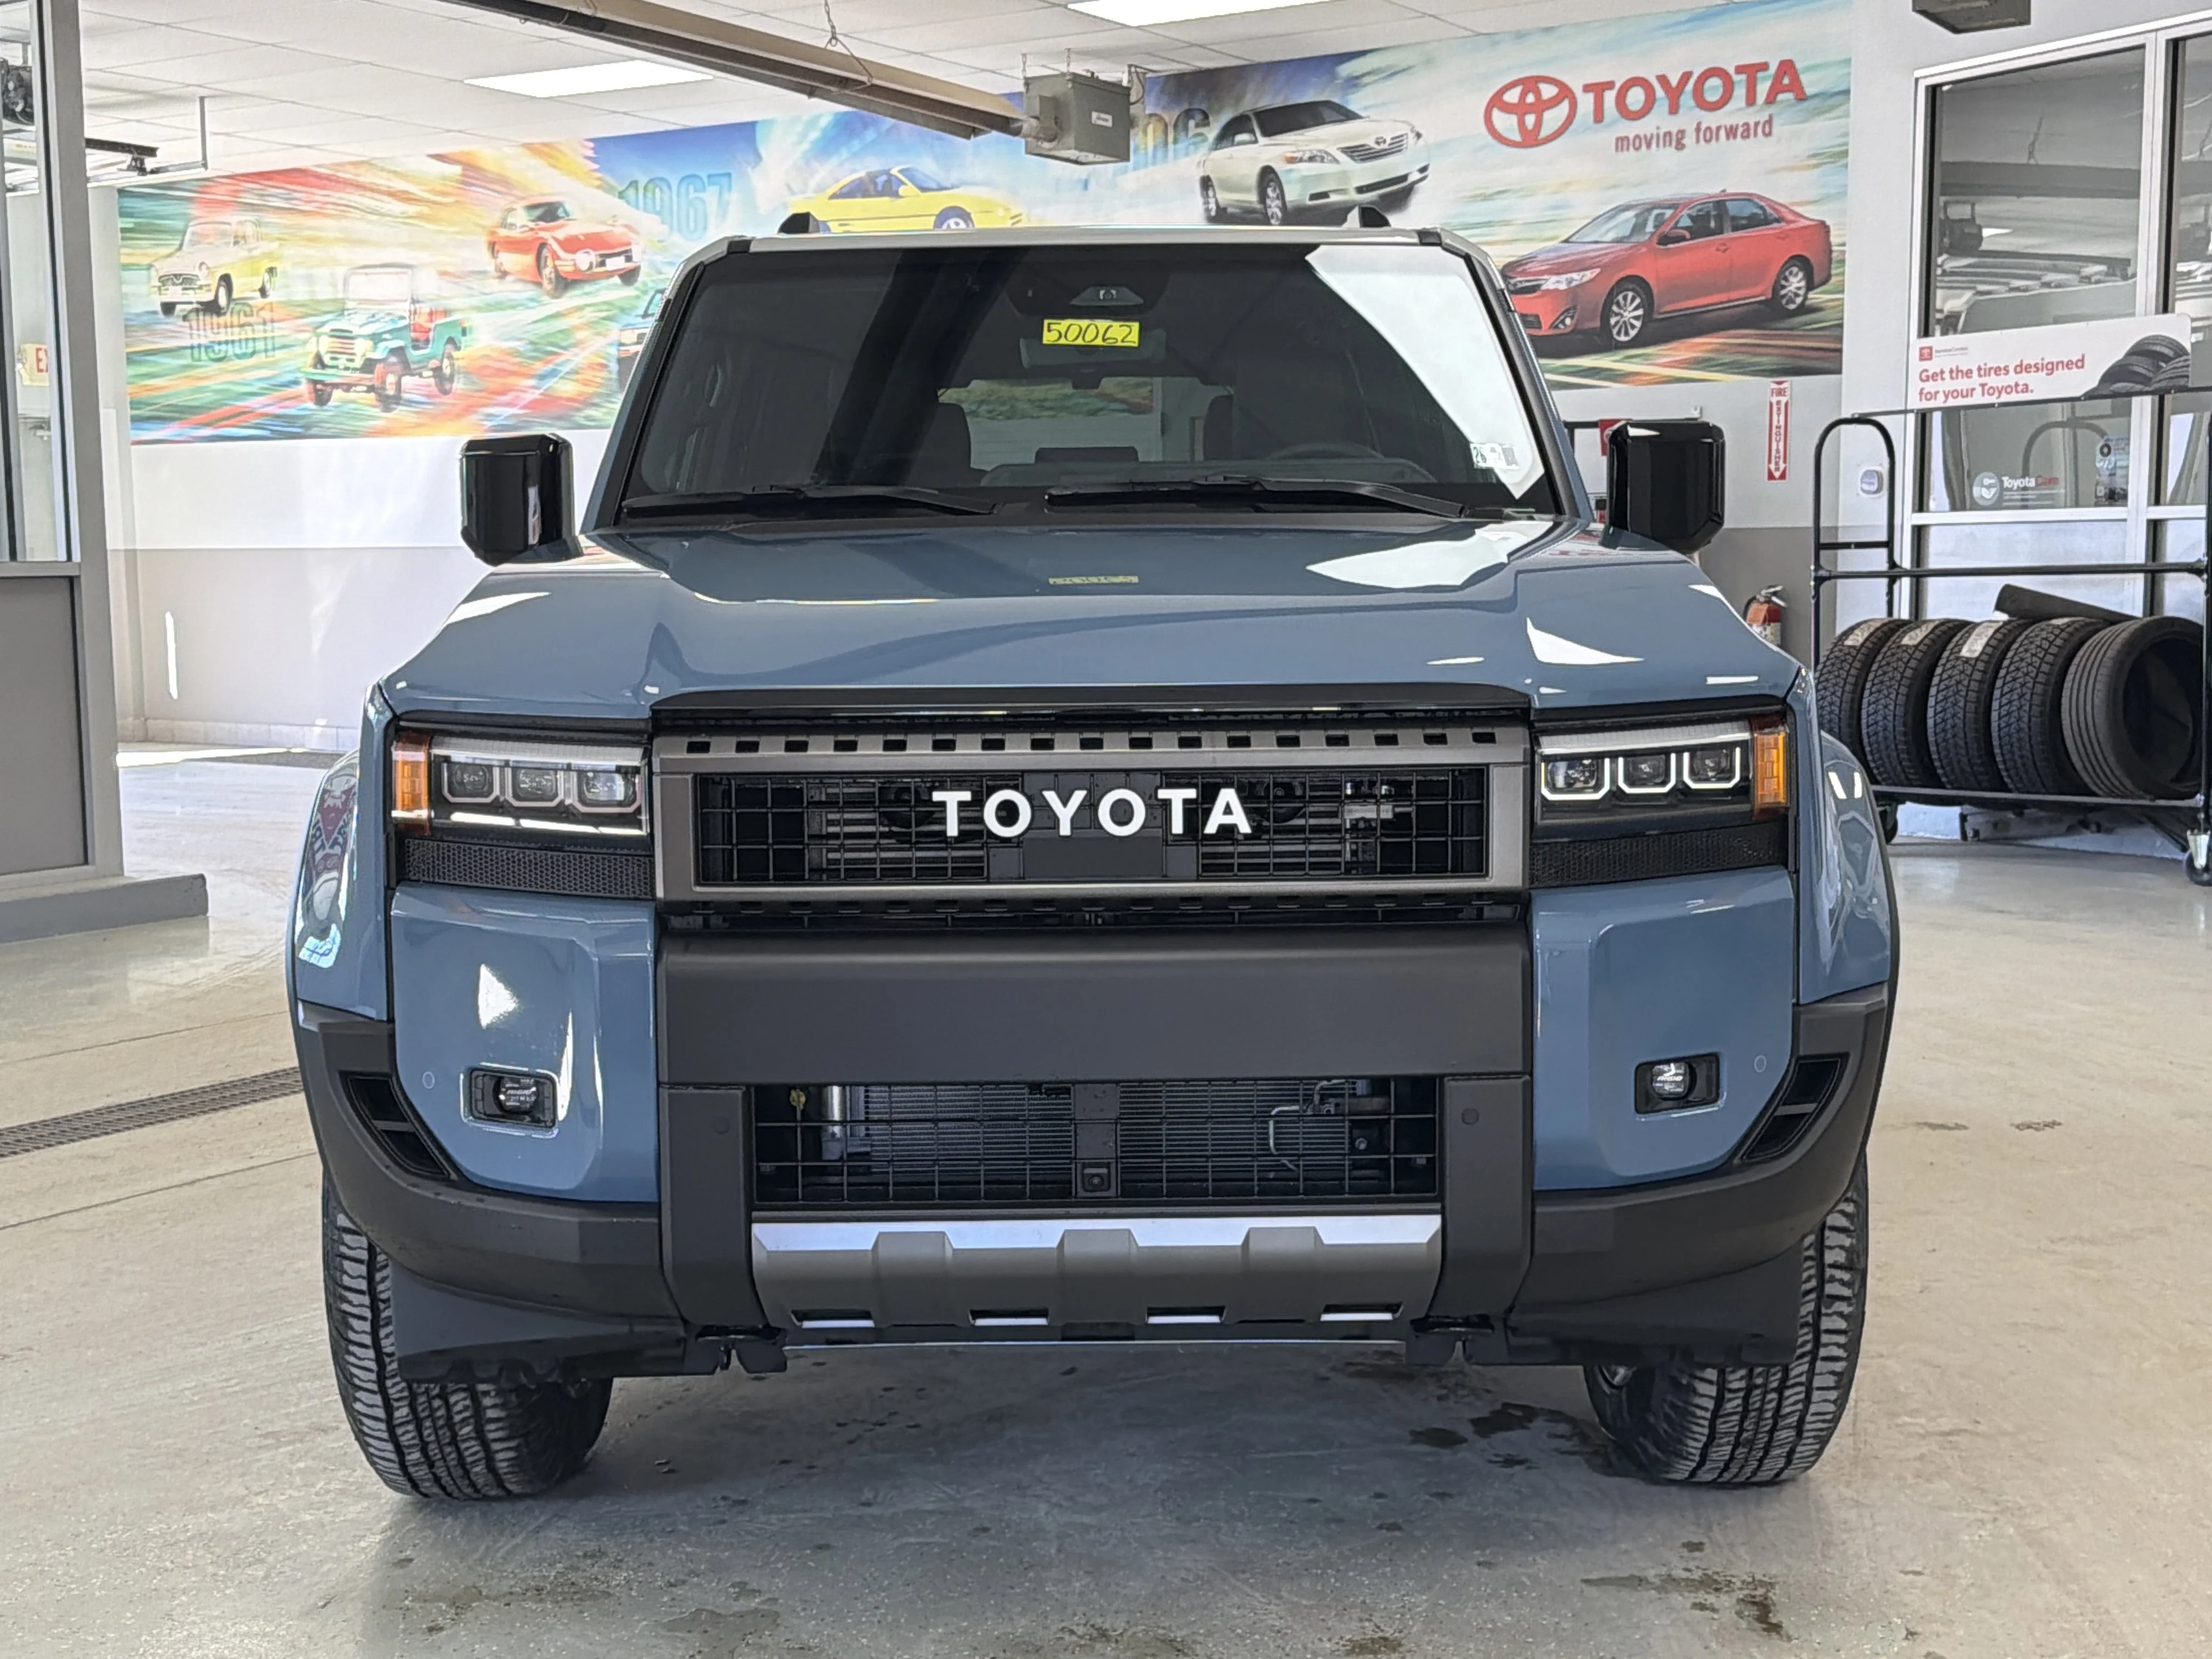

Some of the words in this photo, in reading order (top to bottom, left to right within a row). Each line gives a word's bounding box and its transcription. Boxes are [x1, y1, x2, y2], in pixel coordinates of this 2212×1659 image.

[1583, 59, 1807, 123] TOYOTA
[1614, 126, 1686, 153] moving
[1695, 114, 1774, 144] forward
[618, 172, 732, 240] 1967
[1045, 321, 1137, 345] 50062
[1919, 368, 1945, 382] Get
[1949, 365, 1973, 380] the
[1977, 363, 2010, 378] tires
[2013, 354, 2085, 376] designed
[1771, 387, 1788, 397] FIRE
[1918, 387, 1939, 402] for
[1942, 387, 1976, 403] your
[1978, 381, 2034, 399] Toyota.
[932, 788, 1252, 838] TOYOTA
